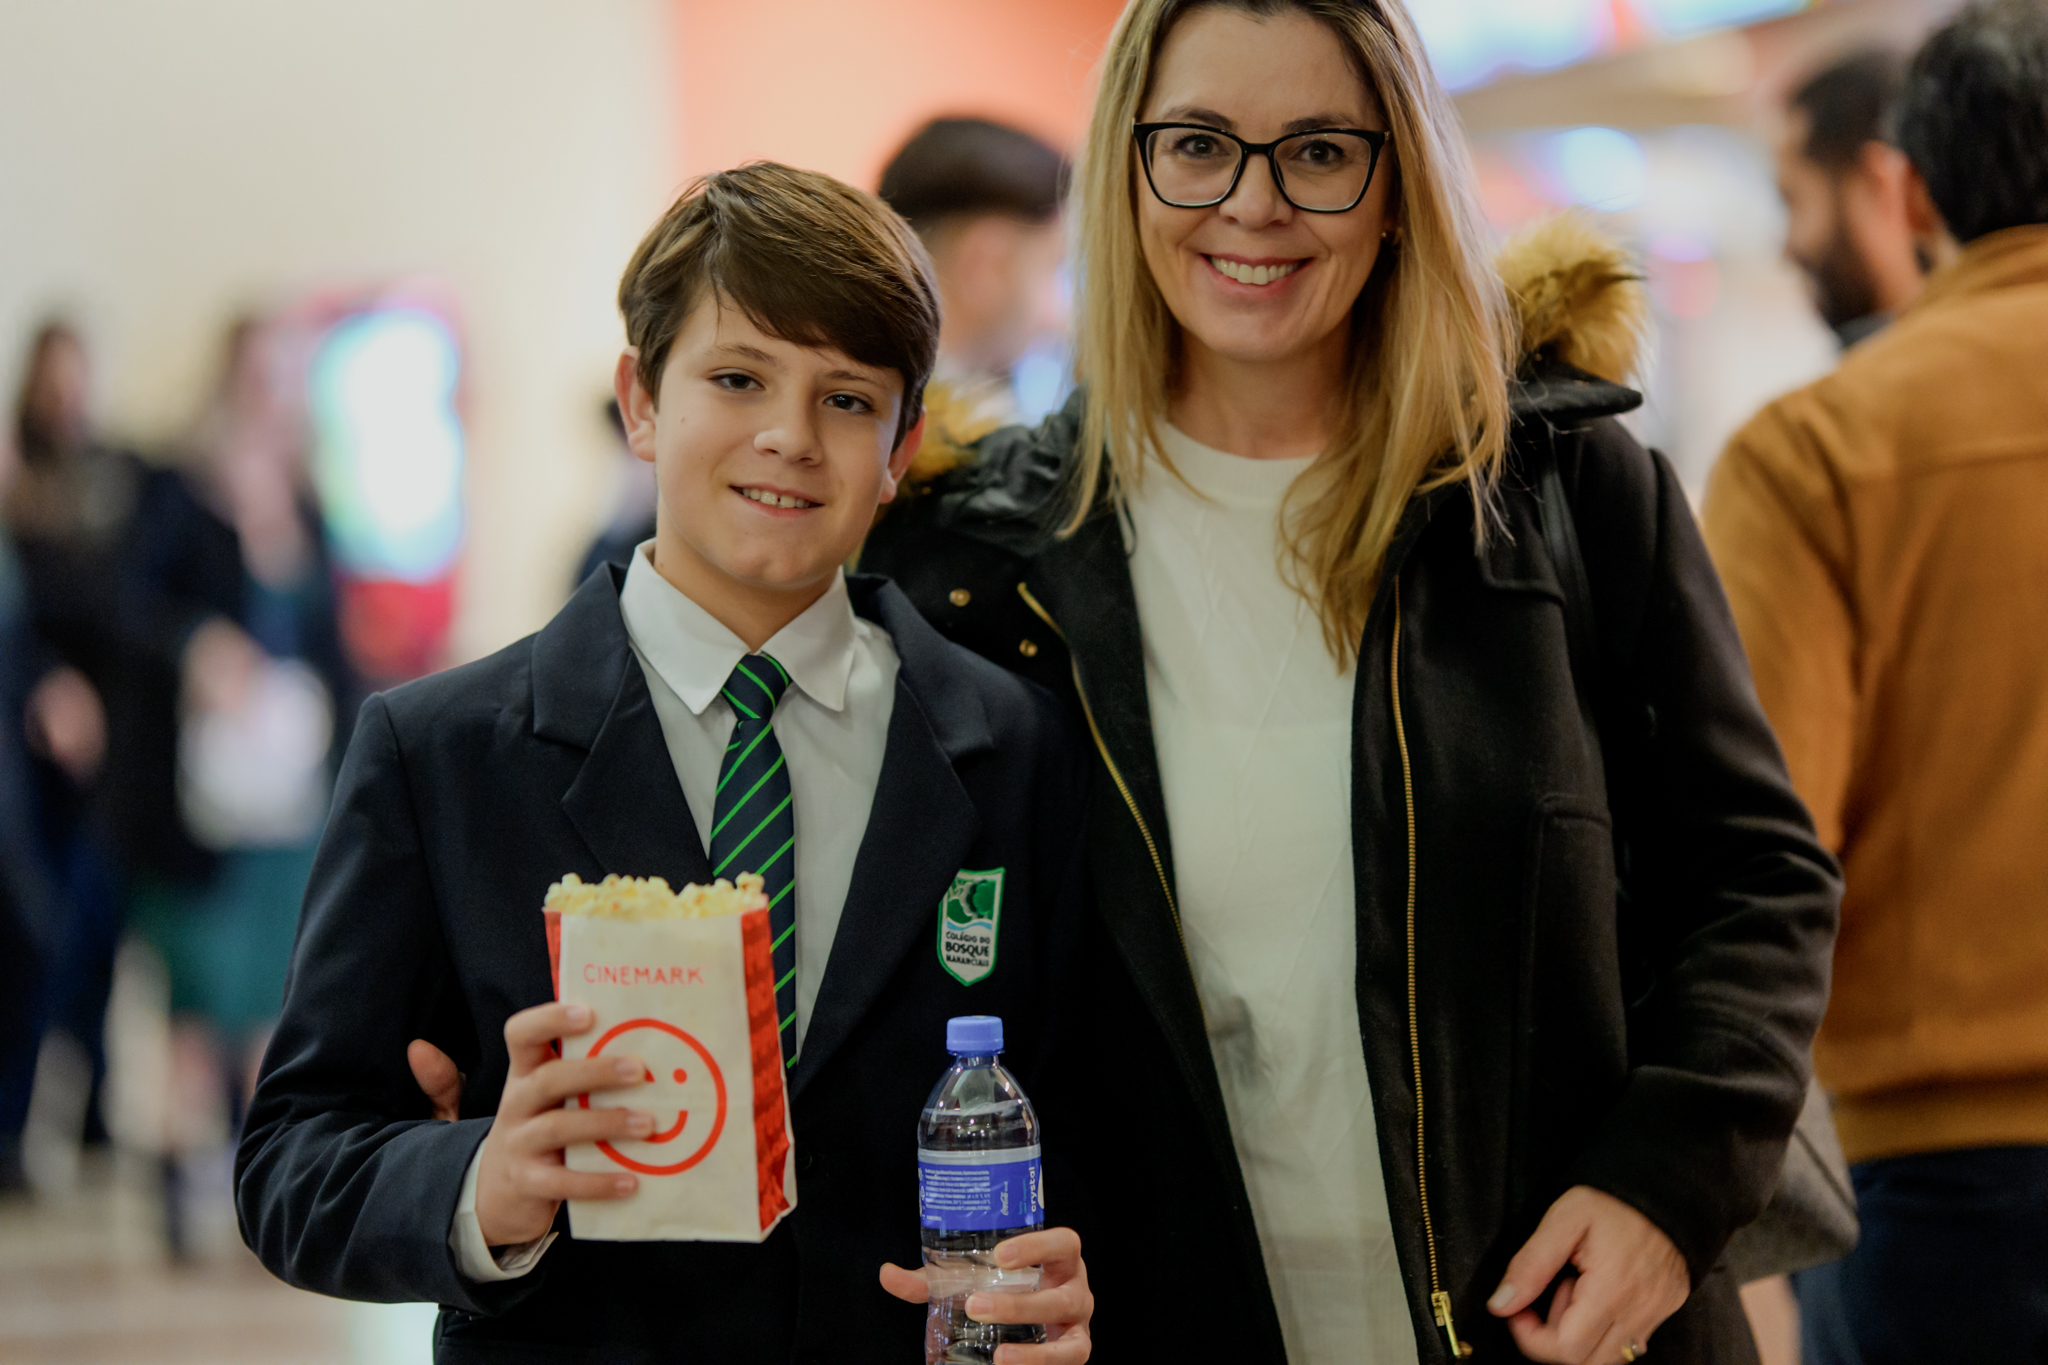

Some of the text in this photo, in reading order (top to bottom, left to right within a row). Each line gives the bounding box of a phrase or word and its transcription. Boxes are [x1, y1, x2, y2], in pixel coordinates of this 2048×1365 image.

[945, 941, 989, 957] BOSQUE
[980, 936, 990, 944] DO
[583, 963, 706, 986] CINEMARK
[1028, 1166, 1037, 1213] crystal
